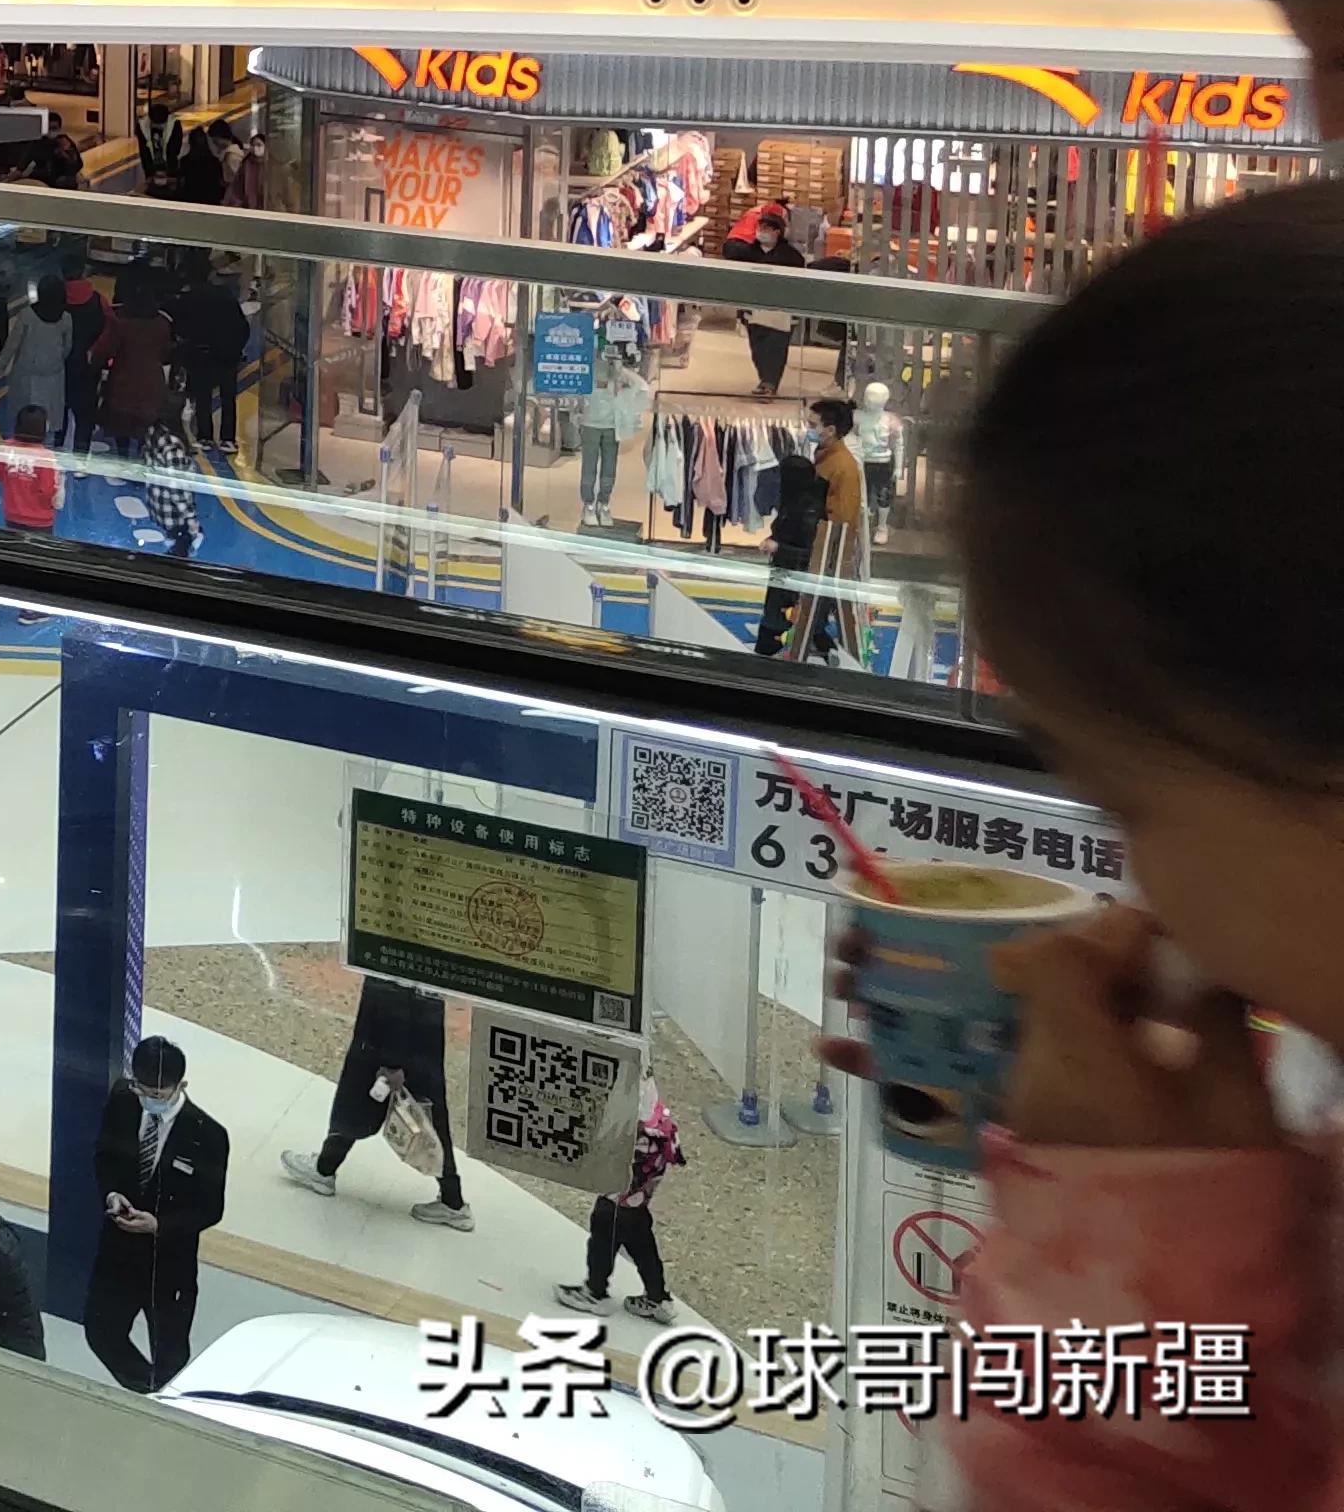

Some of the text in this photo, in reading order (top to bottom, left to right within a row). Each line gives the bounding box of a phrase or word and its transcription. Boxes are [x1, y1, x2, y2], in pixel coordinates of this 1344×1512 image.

[414, 47, 543, 102] kids
[1122, 70, 1290, 130] kids
[375, 132, 485, 178] MAKES
[383, 169, 462, 207] YOUR
[386, 202, 449, 230] DAY
[400, 806, 591, 863] 特种设备使用标志
